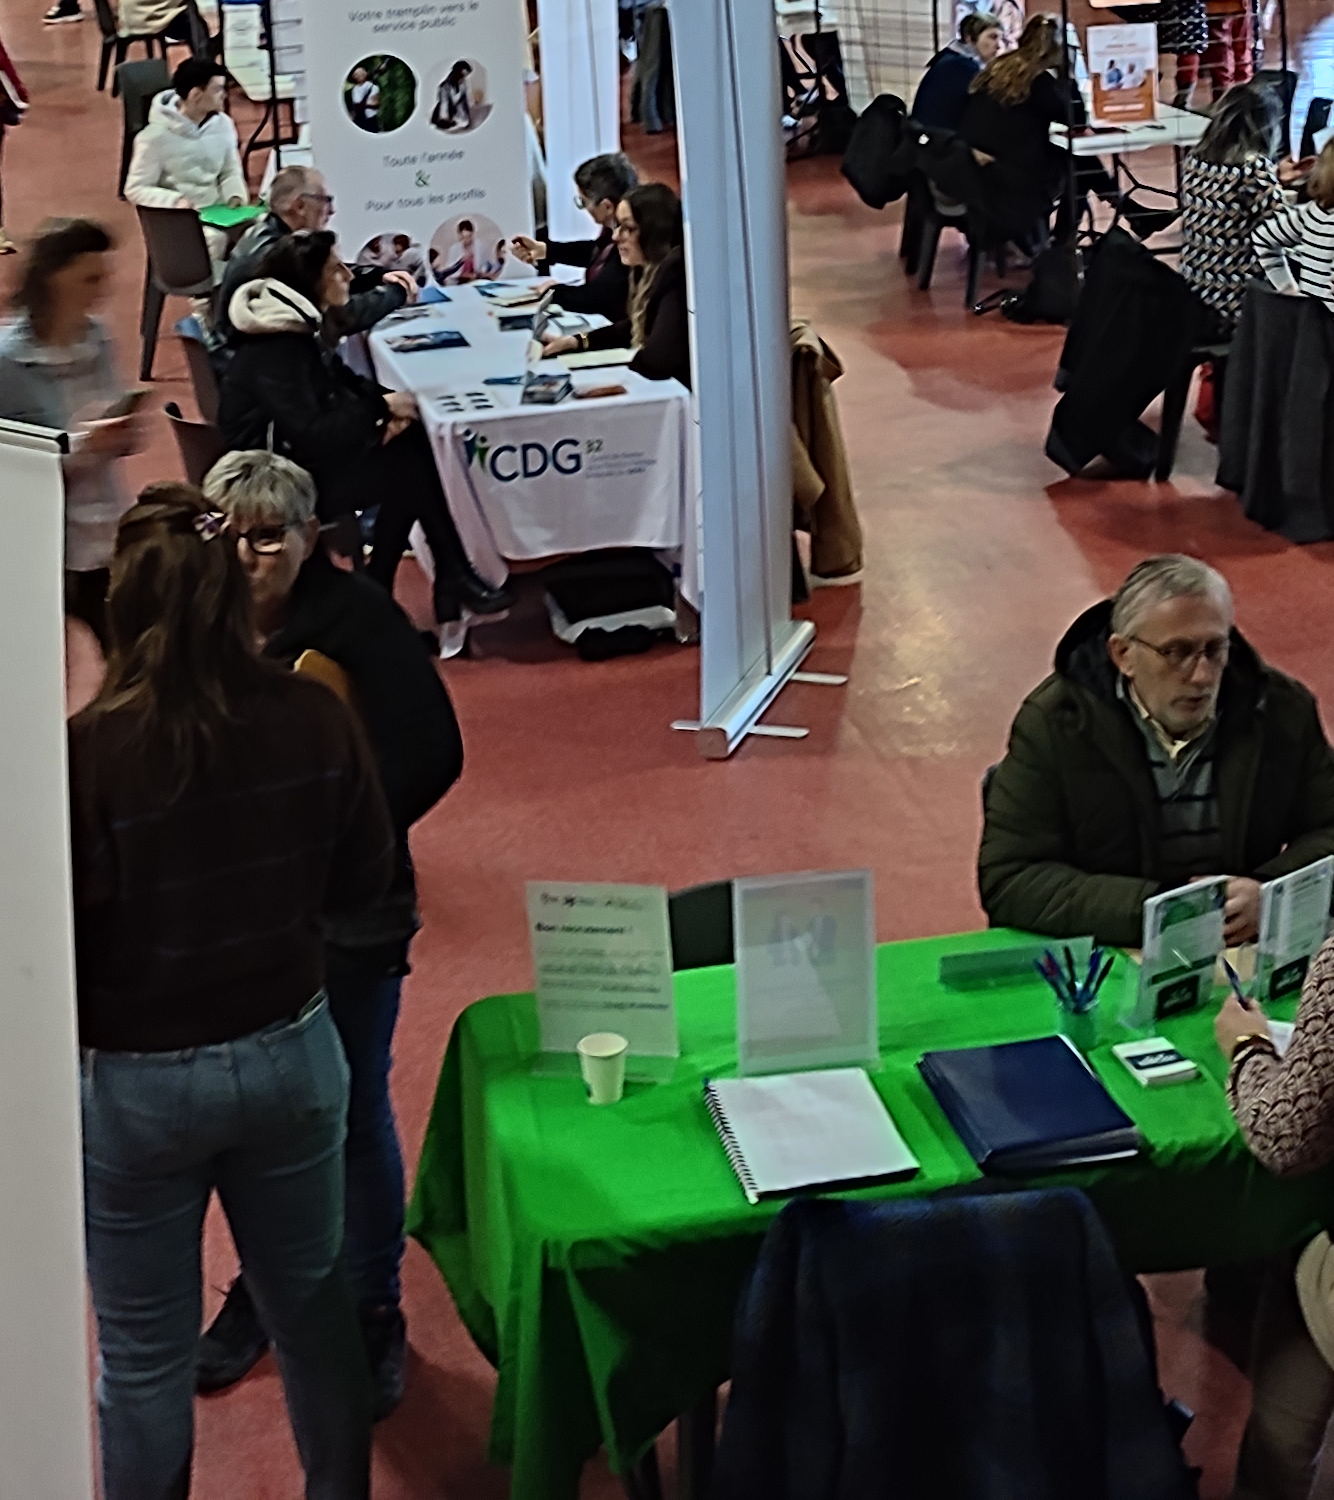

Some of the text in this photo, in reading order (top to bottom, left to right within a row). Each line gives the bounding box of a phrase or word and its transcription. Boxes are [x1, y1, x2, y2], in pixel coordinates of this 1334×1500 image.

[348, 9, 383, 23] Votre
[386, 4, 436, 18] tremplin
[440, 2, 466, 14] vers
[372, 16, 456, 34] service public
[383, 154, 418, 167] Toute
[414, 169, 431, 188] &
[365, 187, 487, 212] Pour tous les profils
[489, 437, 583, 482] CDG
